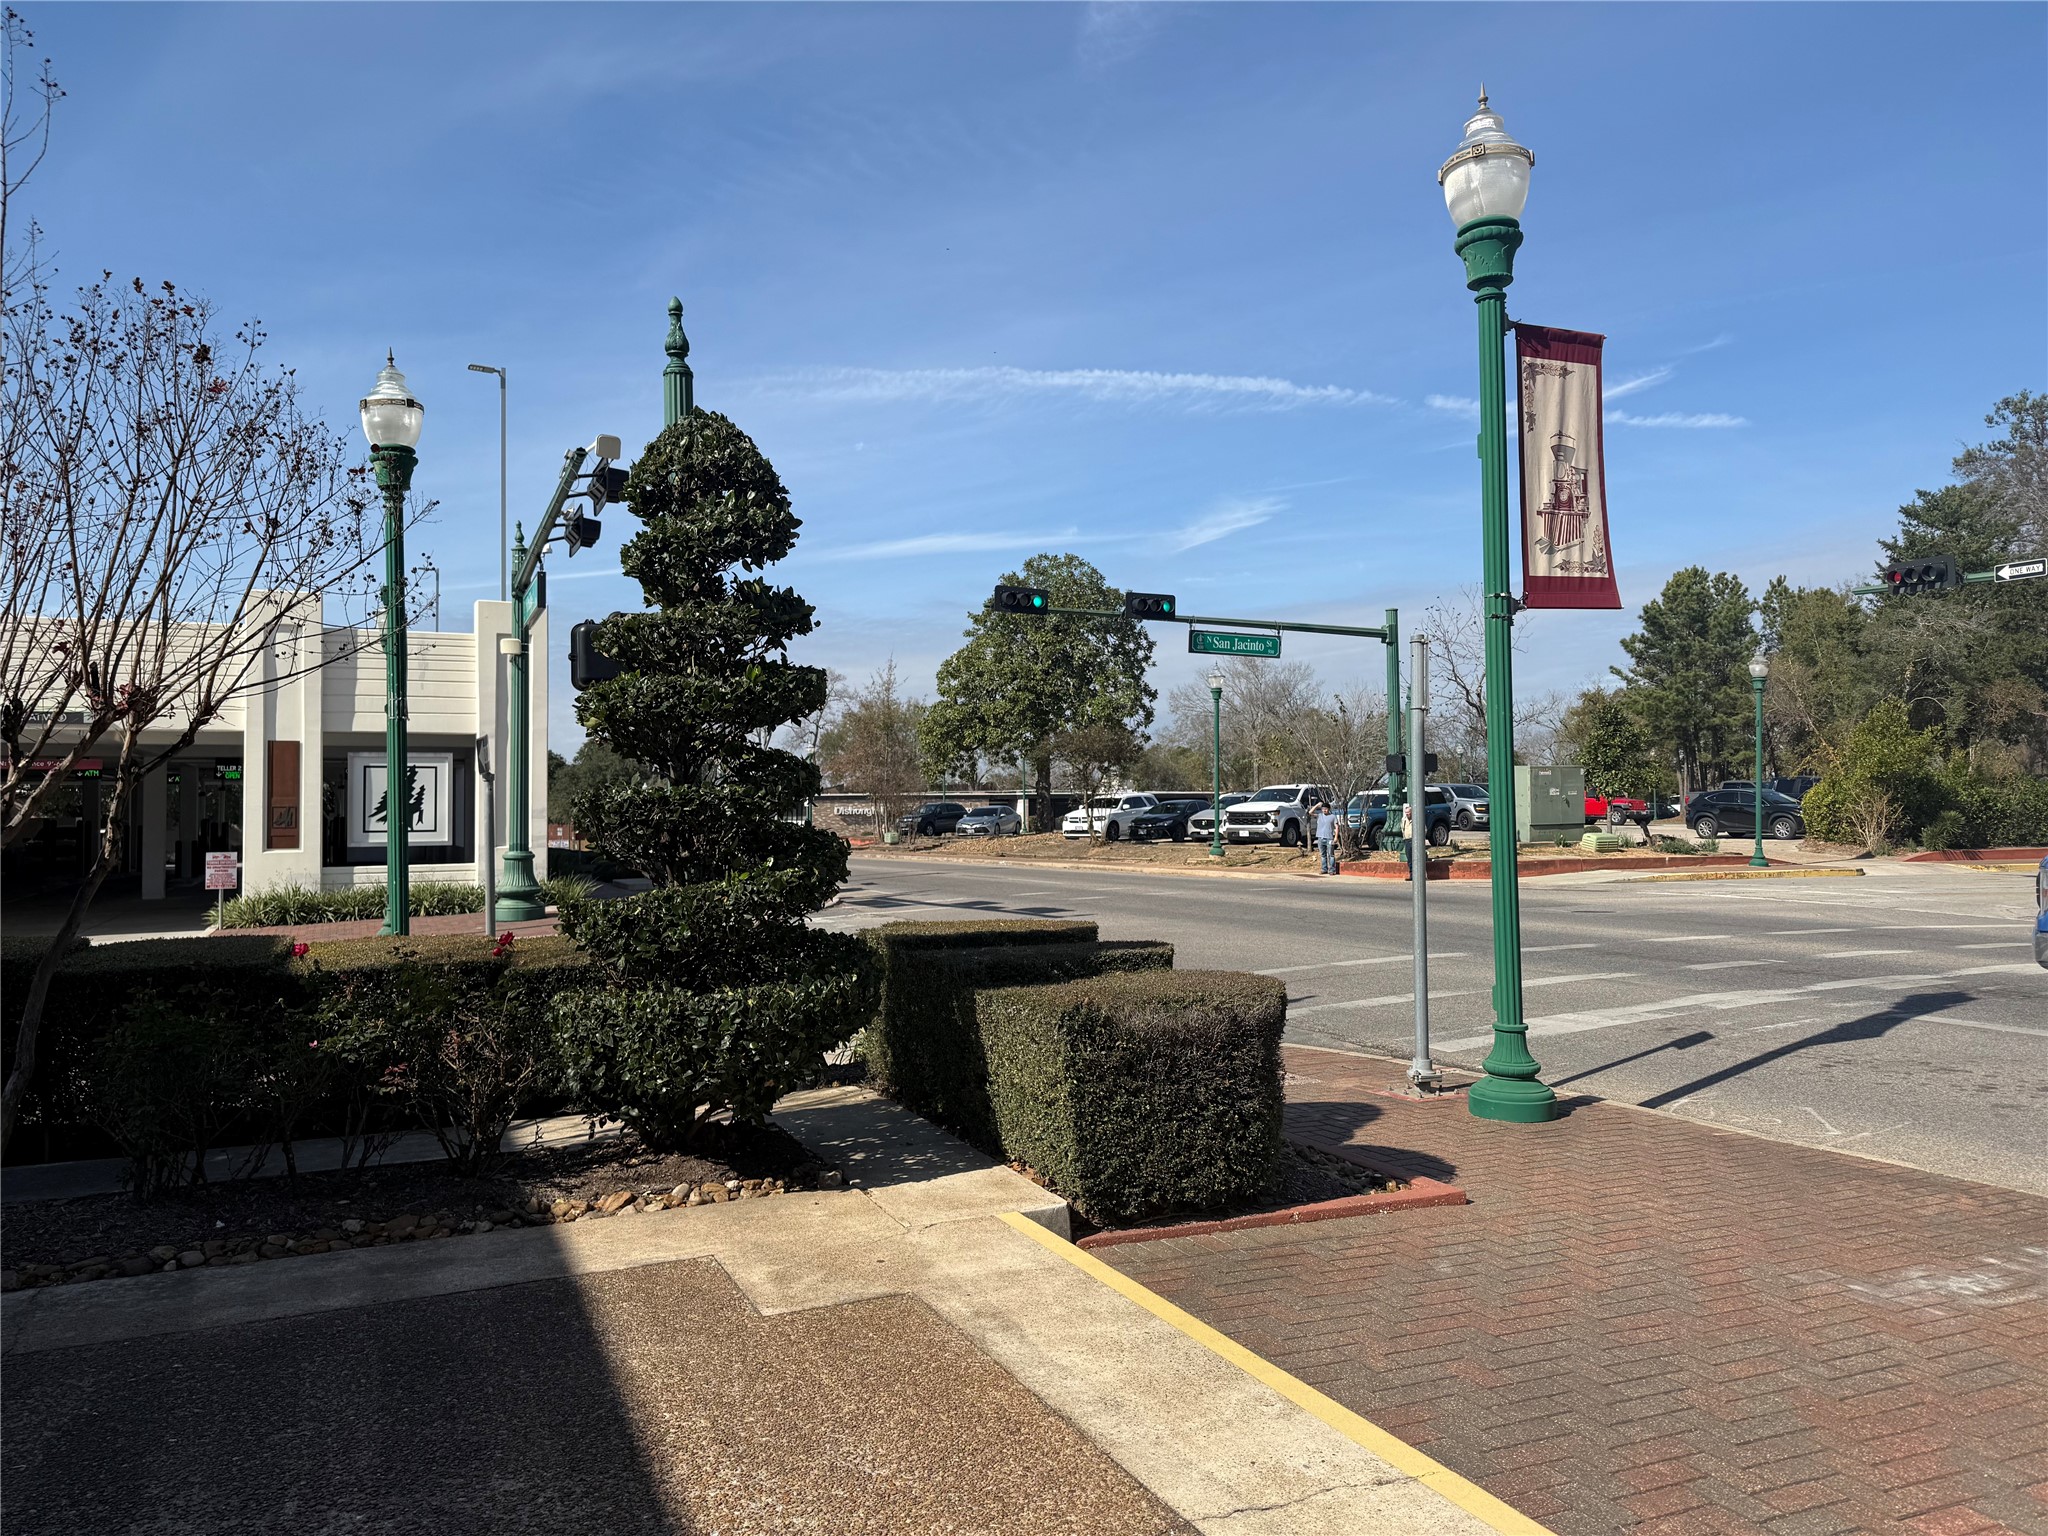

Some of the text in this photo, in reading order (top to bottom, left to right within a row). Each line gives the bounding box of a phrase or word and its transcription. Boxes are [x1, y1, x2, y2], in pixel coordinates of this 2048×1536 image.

[2009, 567, 2023, 575] ONE
[1213, 636, 1230, 649] San
[1232, 638, 1265, 651] Jacinto
